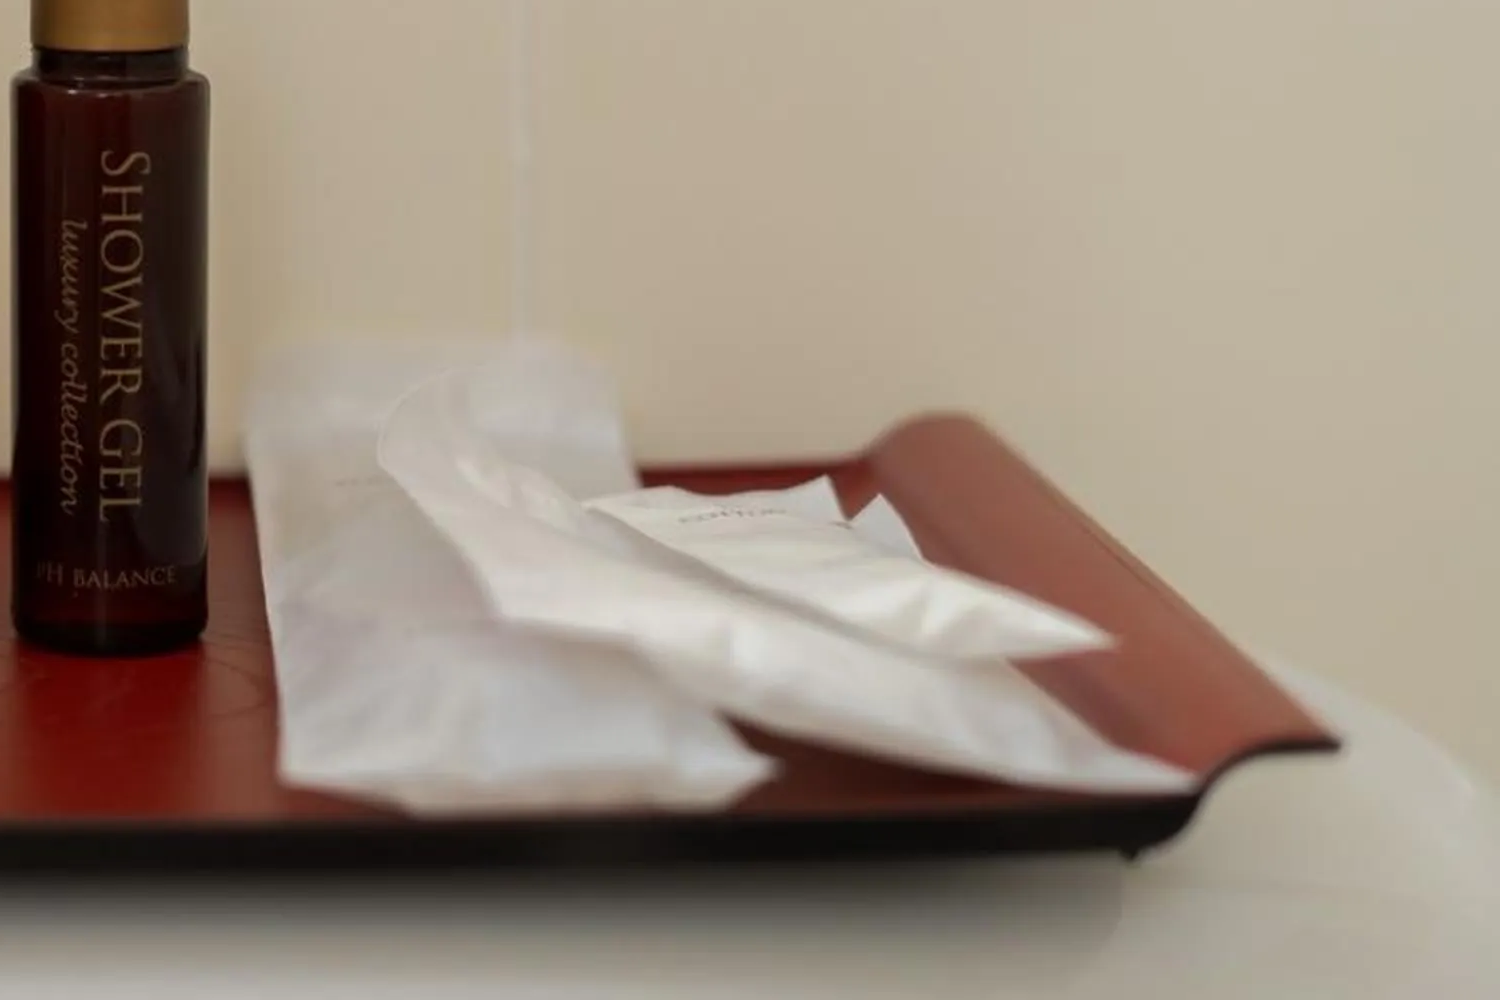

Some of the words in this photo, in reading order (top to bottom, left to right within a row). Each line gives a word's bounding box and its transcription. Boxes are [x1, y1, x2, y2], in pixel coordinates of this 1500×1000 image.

[55, 219, 88, 329] luxury
[100, 149, 152, 405] SHOWER
[59, 342, 88, 516] collection
[99, 420, 144, 522] GEL
[72, 564, 178, 590] BALANCE
